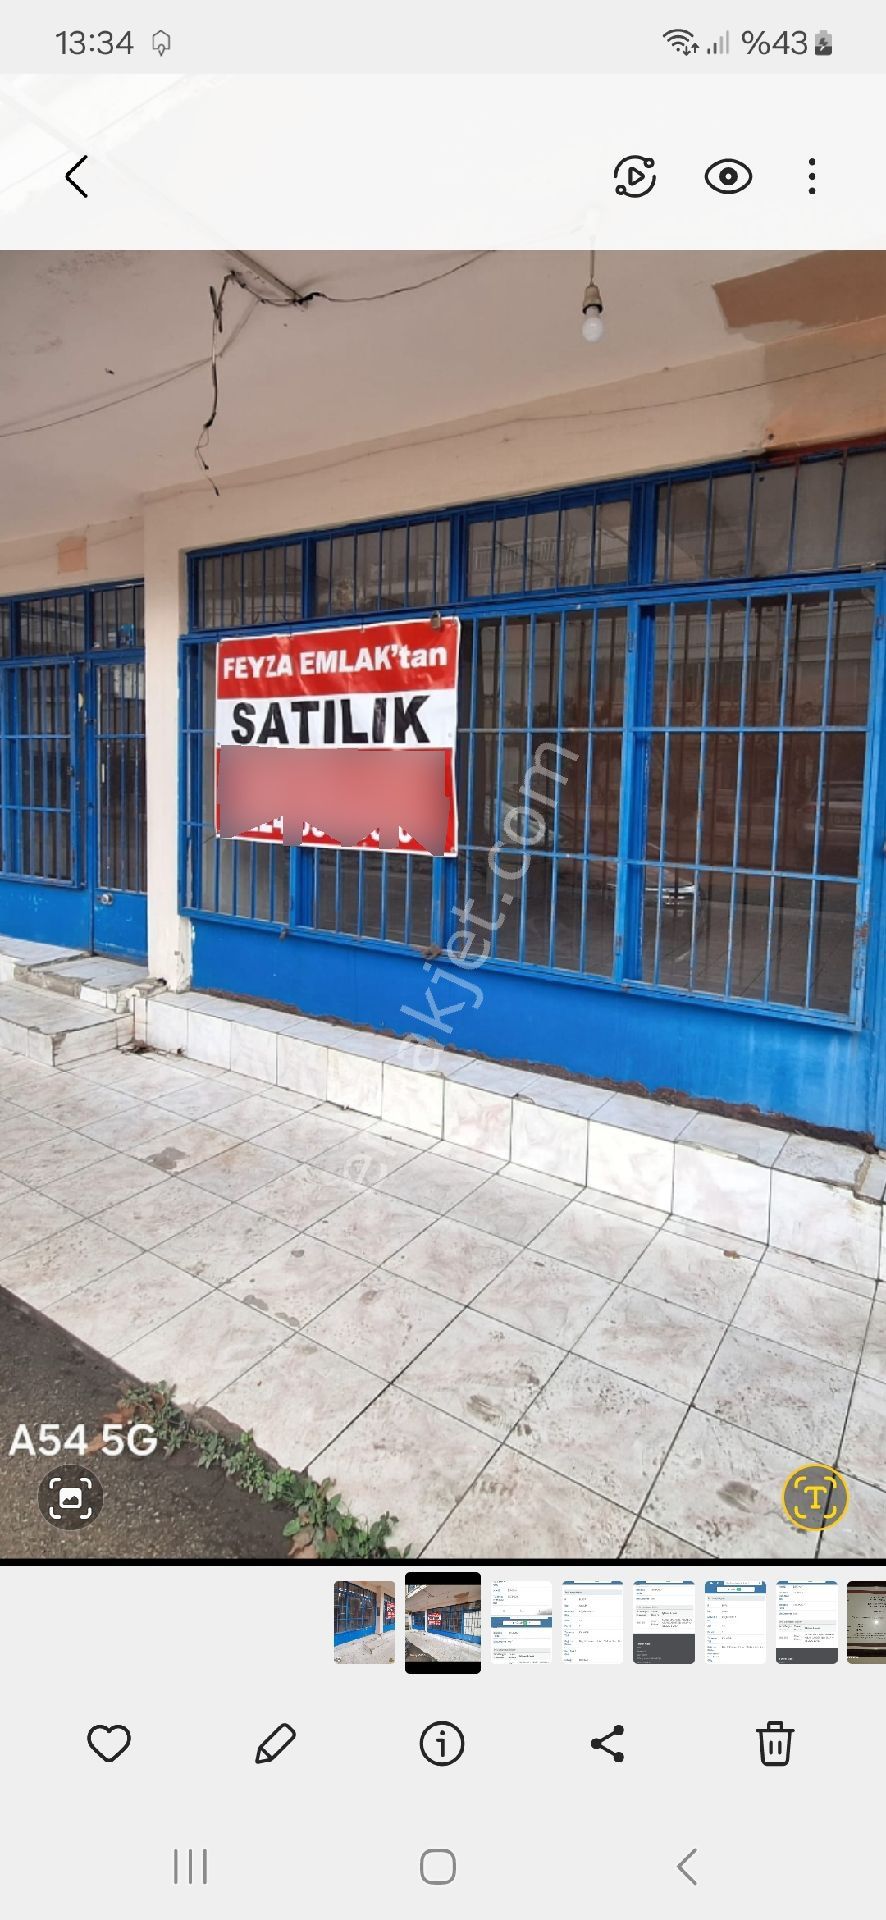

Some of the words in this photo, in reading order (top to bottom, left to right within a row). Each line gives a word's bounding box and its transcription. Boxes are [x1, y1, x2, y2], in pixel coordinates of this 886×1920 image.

[55, 29, 135, 57] 13:34
[742, 29, 809, 57] %43
[223, 654, 293, 680] FEYZA
[231, 695, 431, 744] SATILIK
